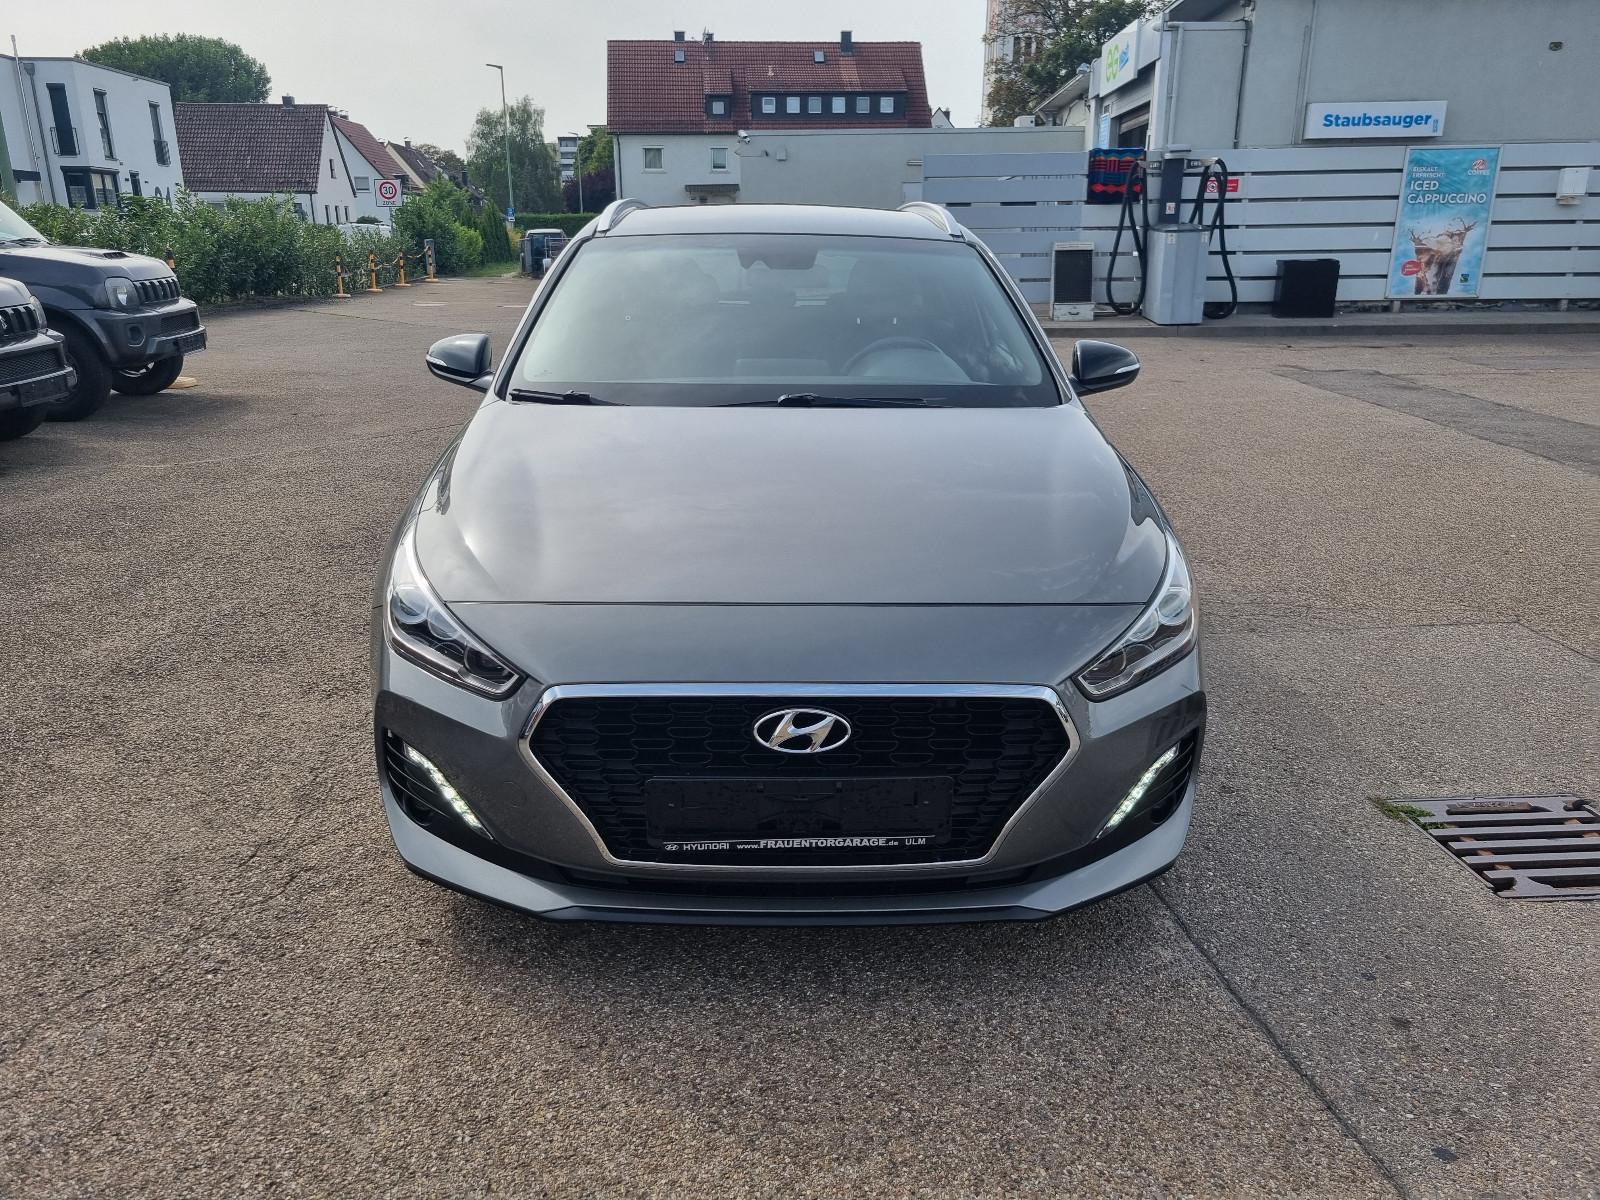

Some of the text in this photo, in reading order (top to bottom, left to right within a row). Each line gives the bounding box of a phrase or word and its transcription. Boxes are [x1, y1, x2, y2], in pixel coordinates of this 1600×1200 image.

[1322, 113, 1432, 128] Staubsauger
[383, 186, 393, 195] 30
[1410, 180, 1439, 191] ICED
[1407, 193, 1487, 204] CAPPUCCINO
[683, 837, 926, 851] HYUNDAI www.FRAUENTORGARAGE.de ULM
